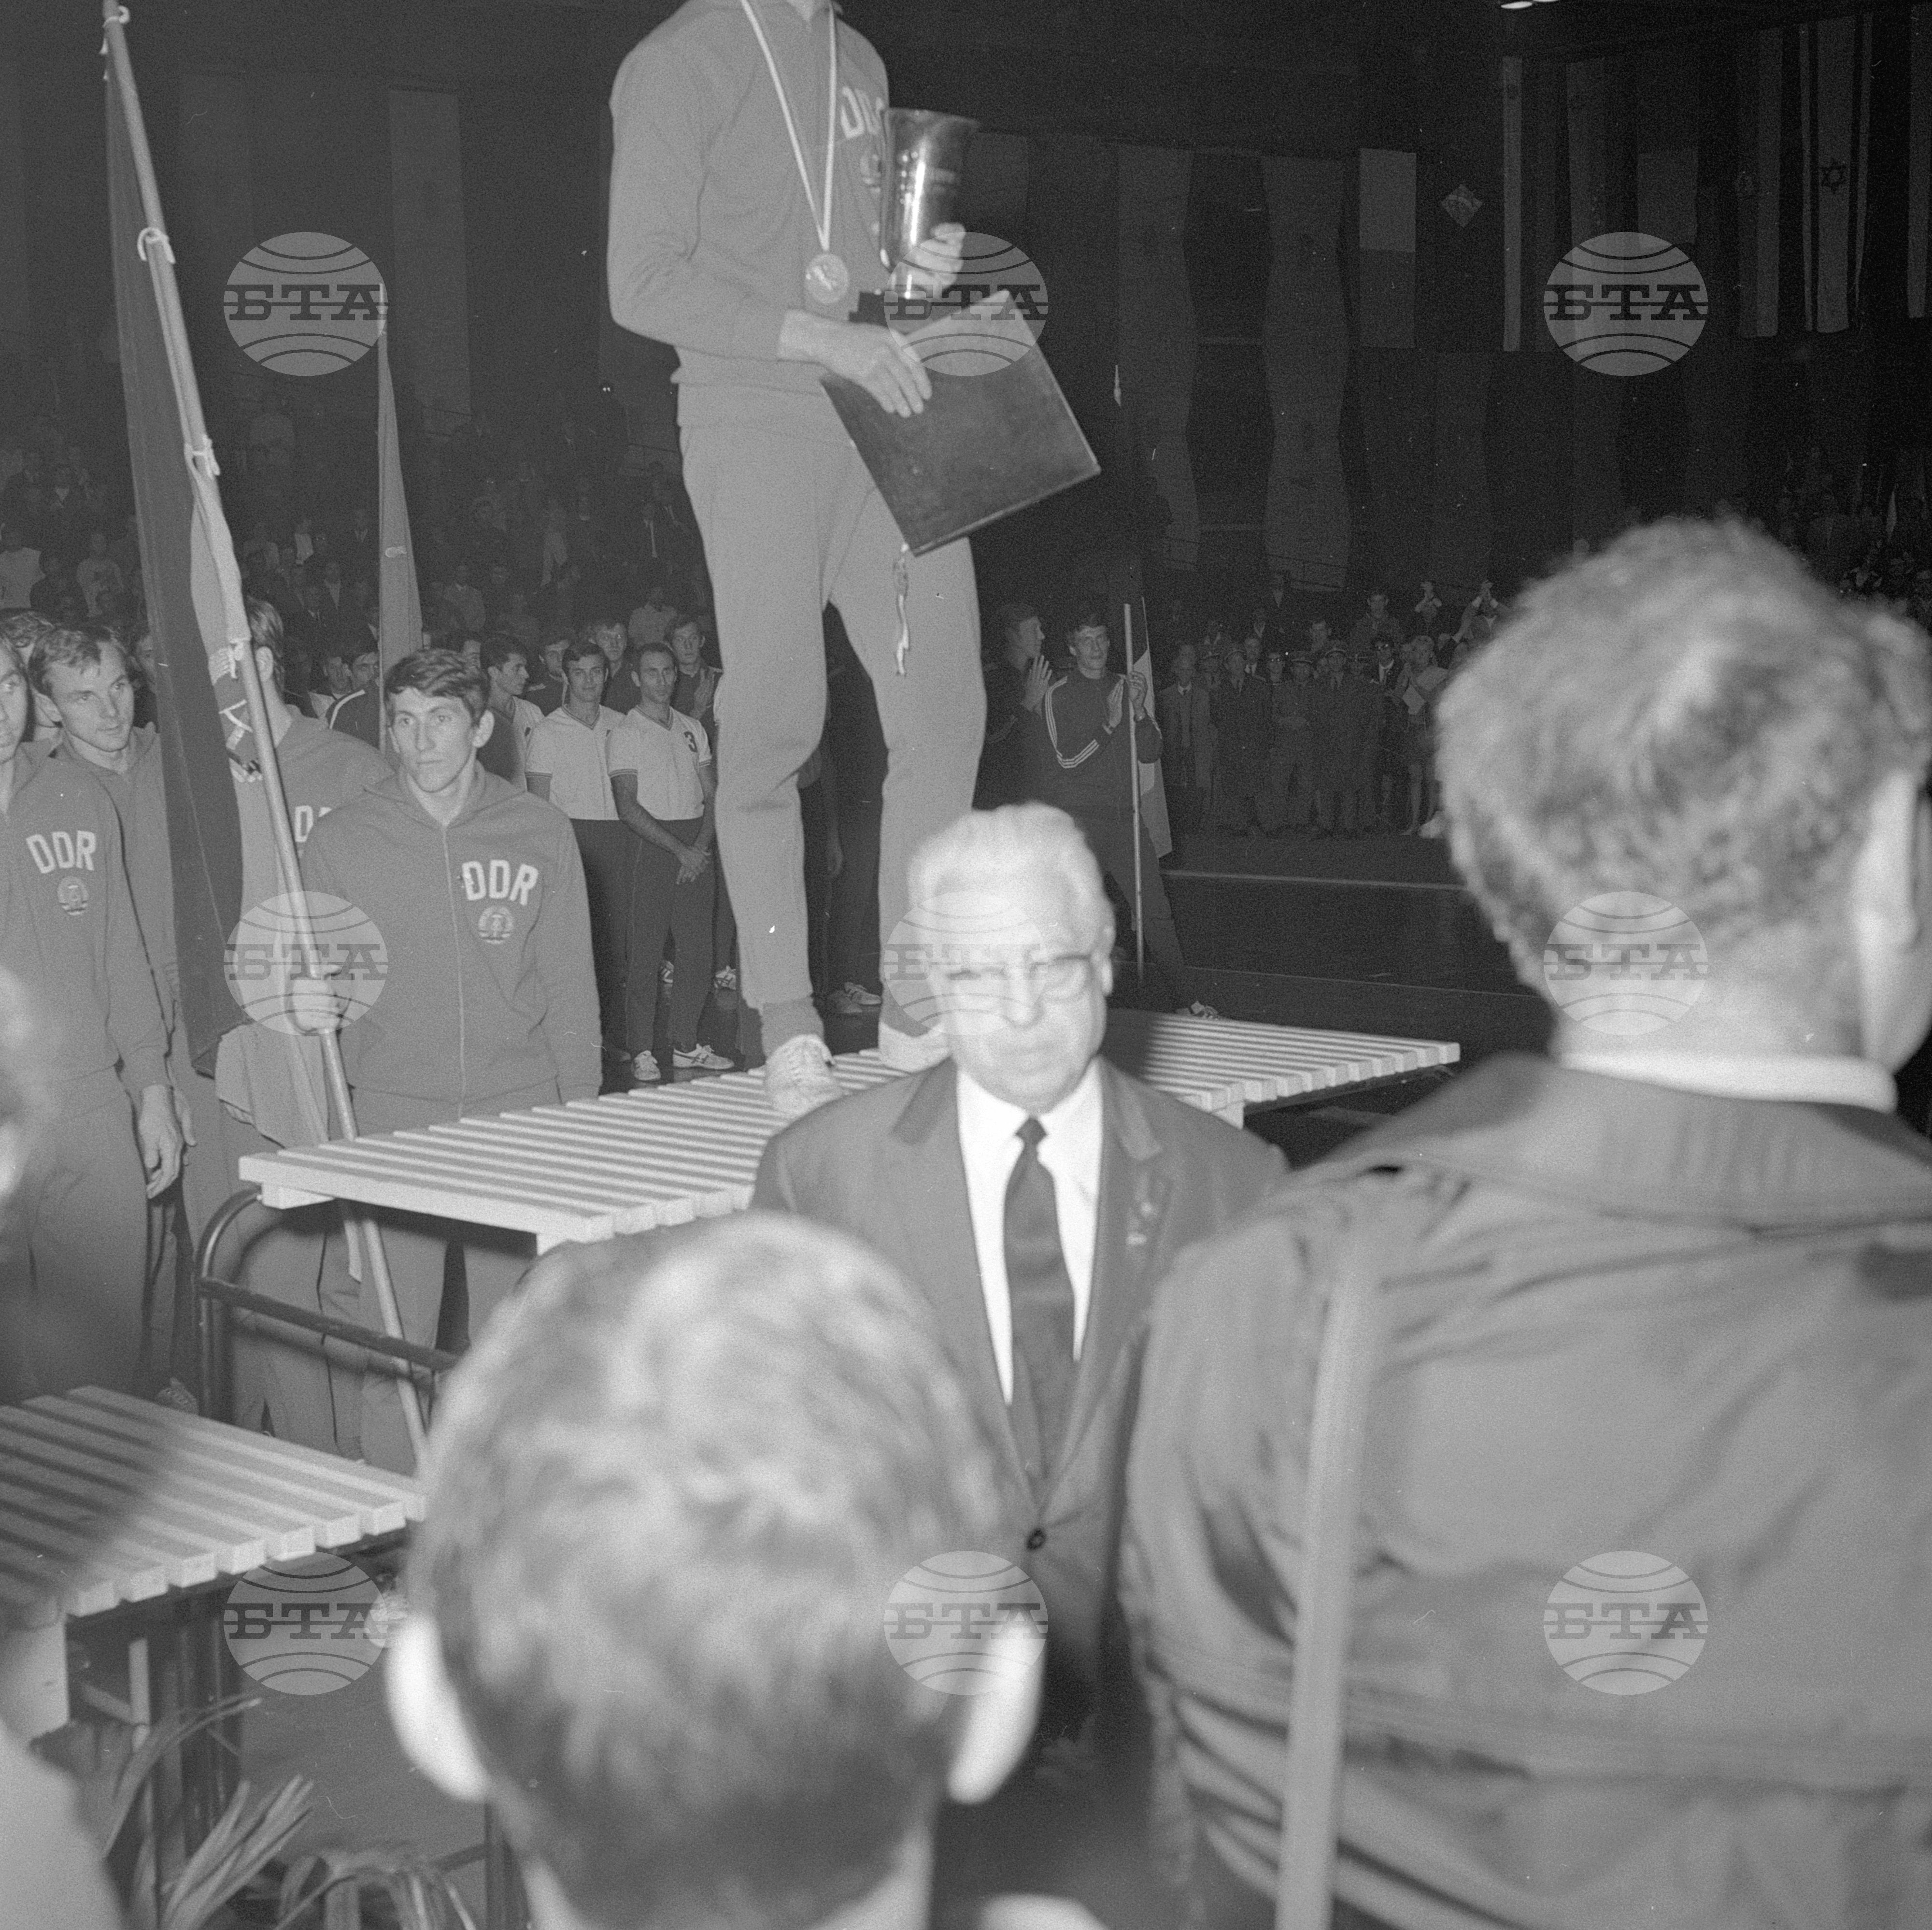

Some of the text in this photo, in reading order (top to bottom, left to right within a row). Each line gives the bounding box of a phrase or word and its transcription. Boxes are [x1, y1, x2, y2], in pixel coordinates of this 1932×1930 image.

[841, 86, 885, 139] DD
[684, 731, 698, 753] 3
[294, 805, 333, 843] D
[26, 830, 96, 874] DDR
[461, 859, 539, 906] DDR
